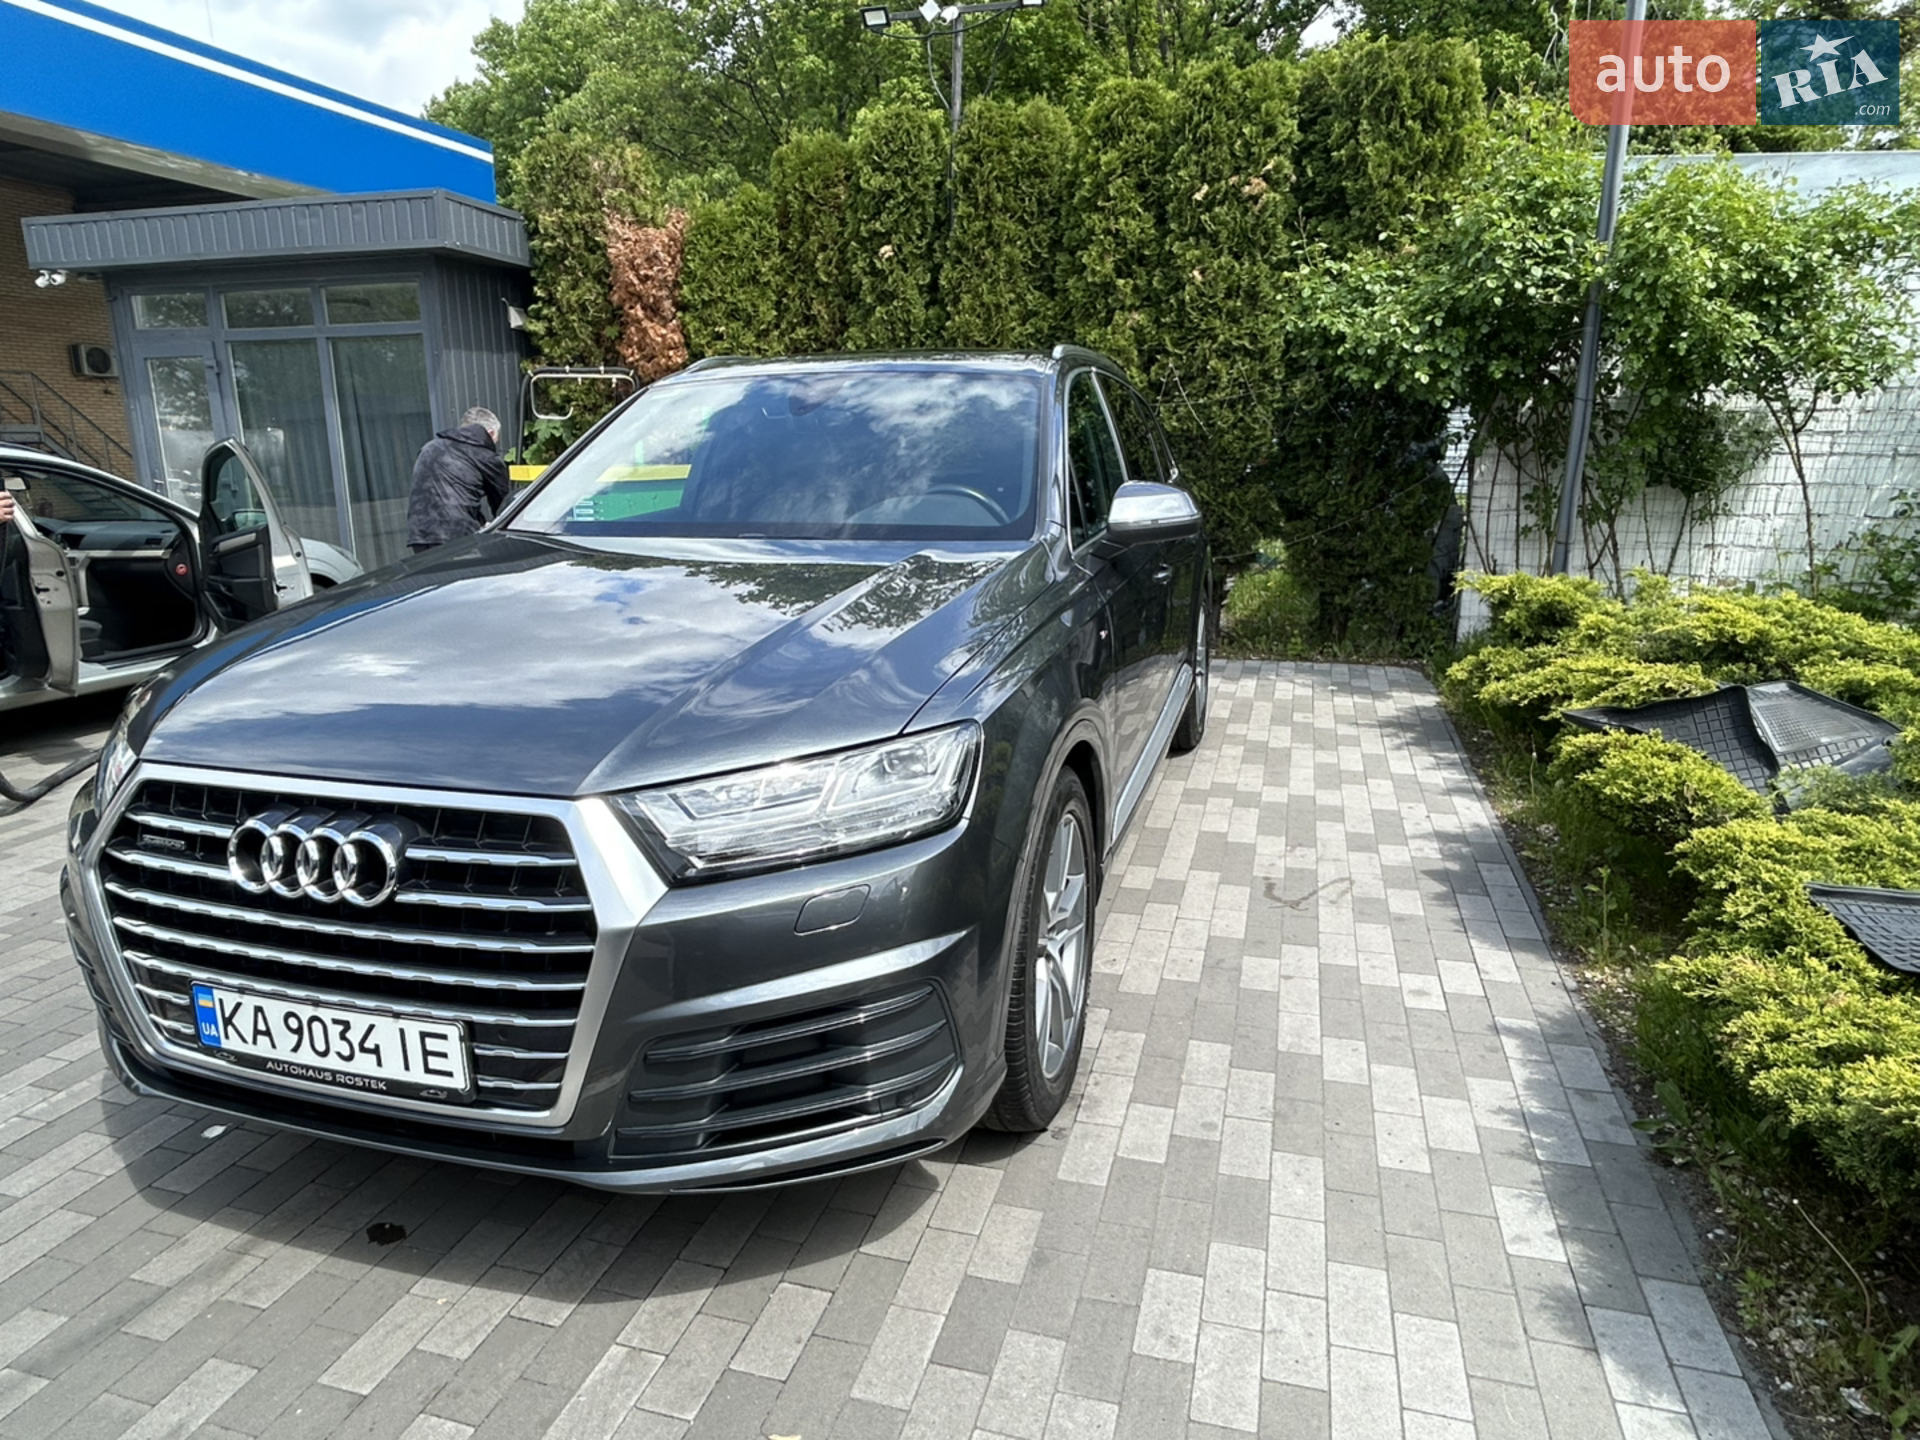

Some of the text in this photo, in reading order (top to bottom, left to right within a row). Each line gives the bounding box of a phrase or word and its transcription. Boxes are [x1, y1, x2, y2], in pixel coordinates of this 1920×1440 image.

[201, 1022, 219, 1037] UA
[218, 998, 455, 1079] KA 9034 IE
[266, 1060, 387, 1090] AUTOHAUS ROSTEK
